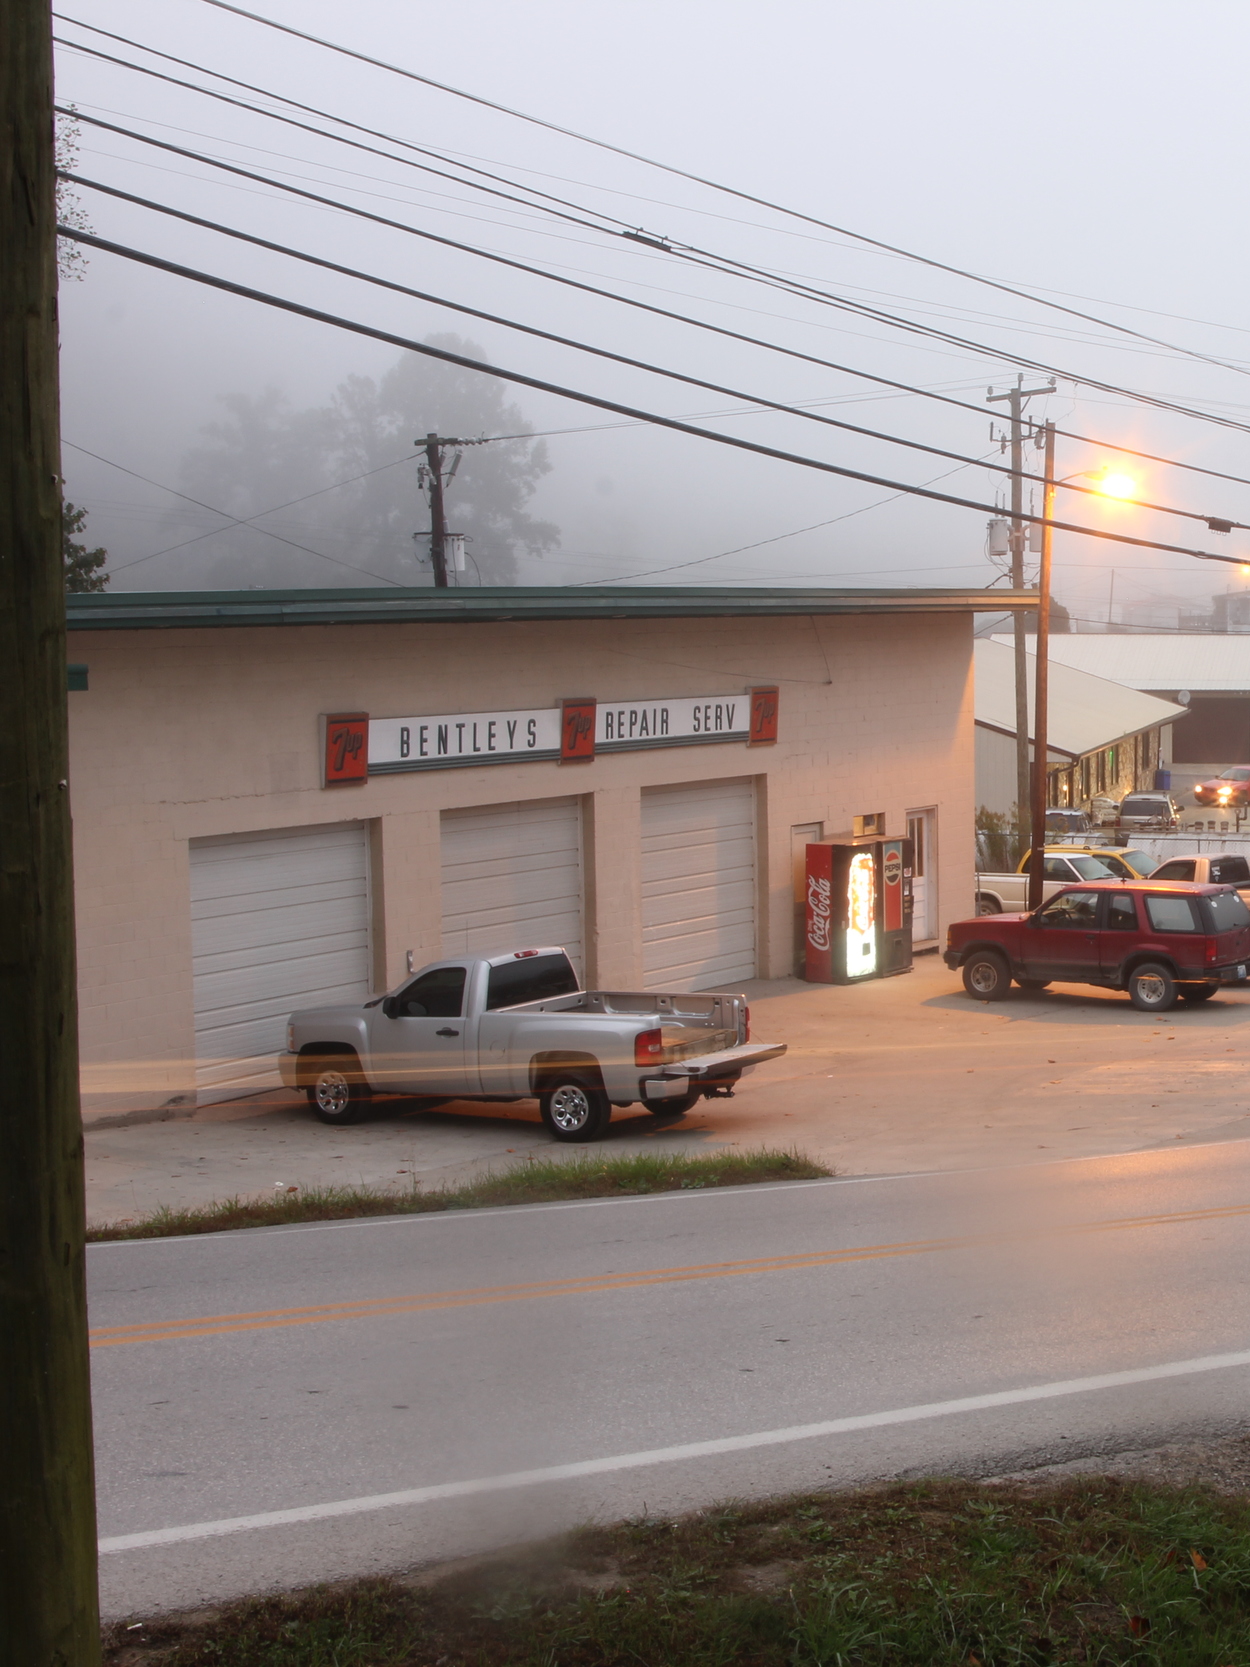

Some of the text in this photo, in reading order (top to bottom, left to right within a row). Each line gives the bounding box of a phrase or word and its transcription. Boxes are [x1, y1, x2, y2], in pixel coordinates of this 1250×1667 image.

[400, 703, 736, 758] BENTLEYS REPAIR SERV
[884, 863, 901, 872] PEPSI
